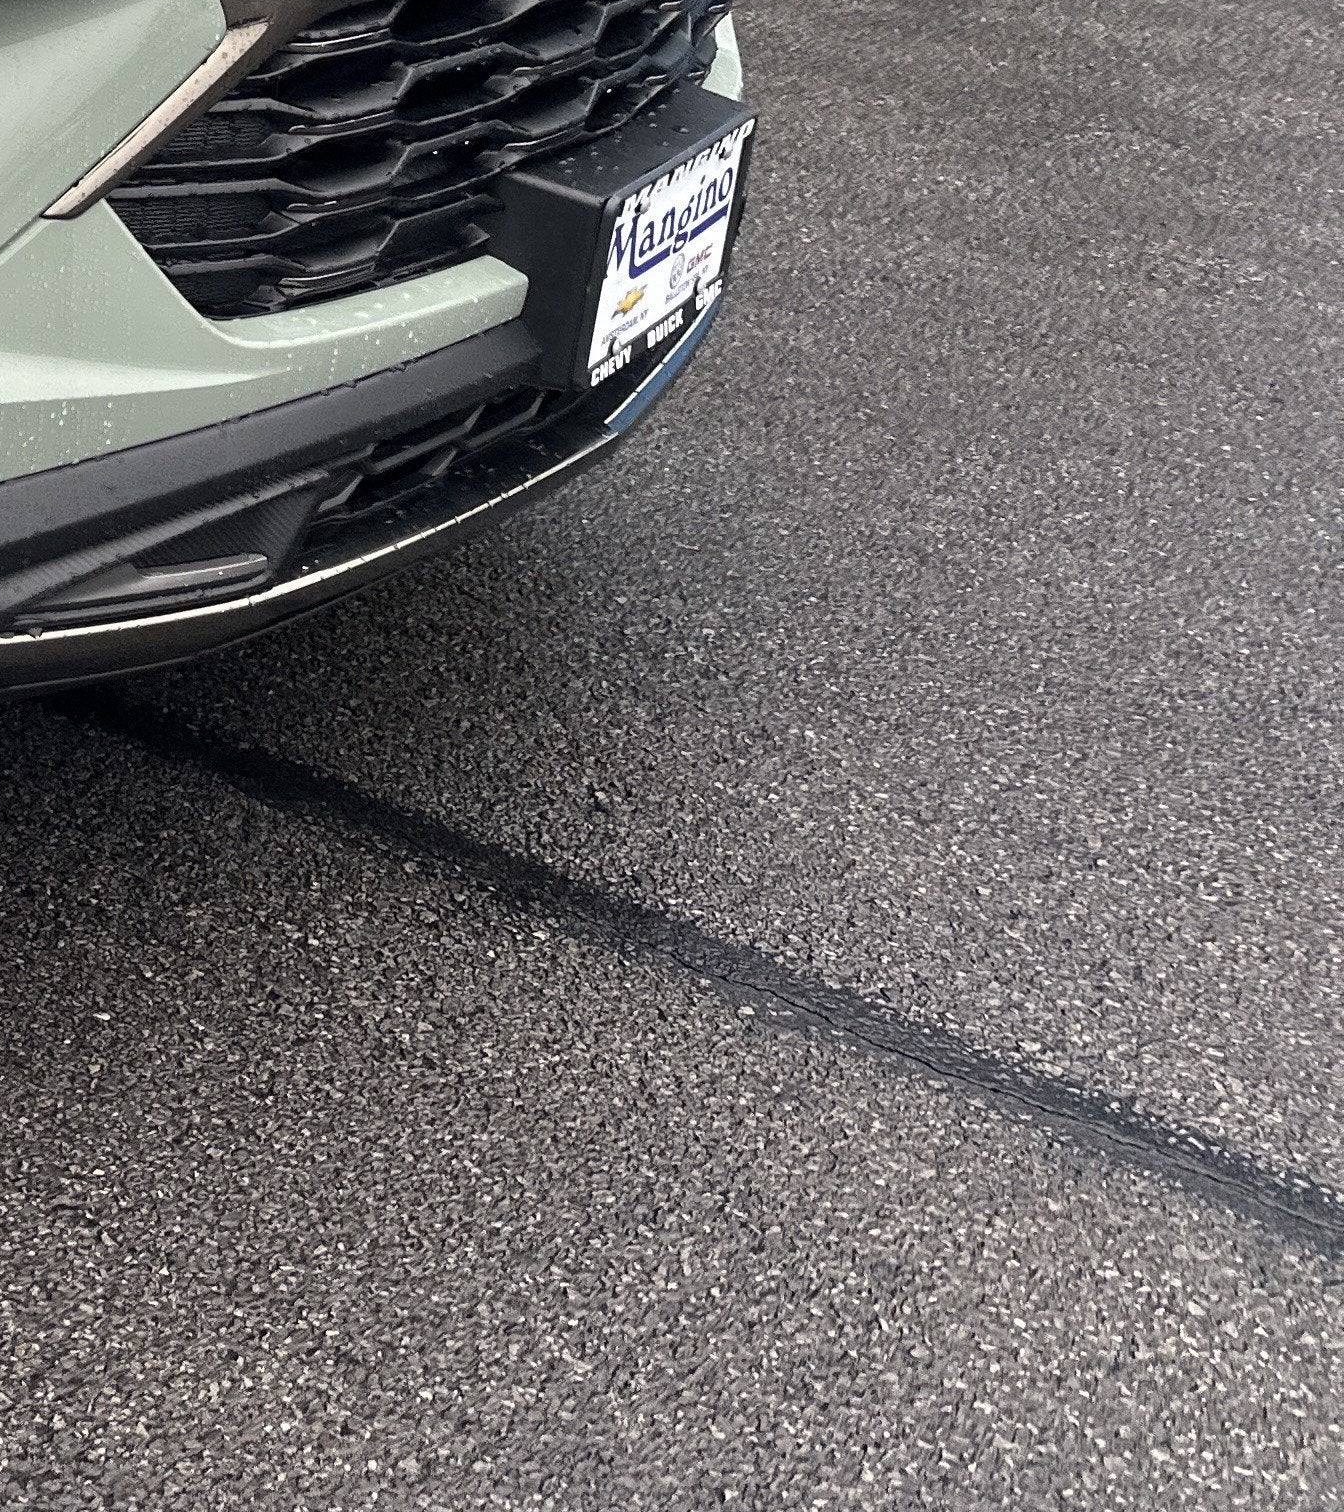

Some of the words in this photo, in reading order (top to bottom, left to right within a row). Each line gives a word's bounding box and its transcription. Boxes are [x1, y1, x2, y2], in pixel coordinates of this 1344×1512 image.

[607, 167, 733, 279] Mangino
[591, 345, 632, 387] CHEVY
[647, 308, 684, 349] BUICK
[695, 279, 723, 311] GMC
